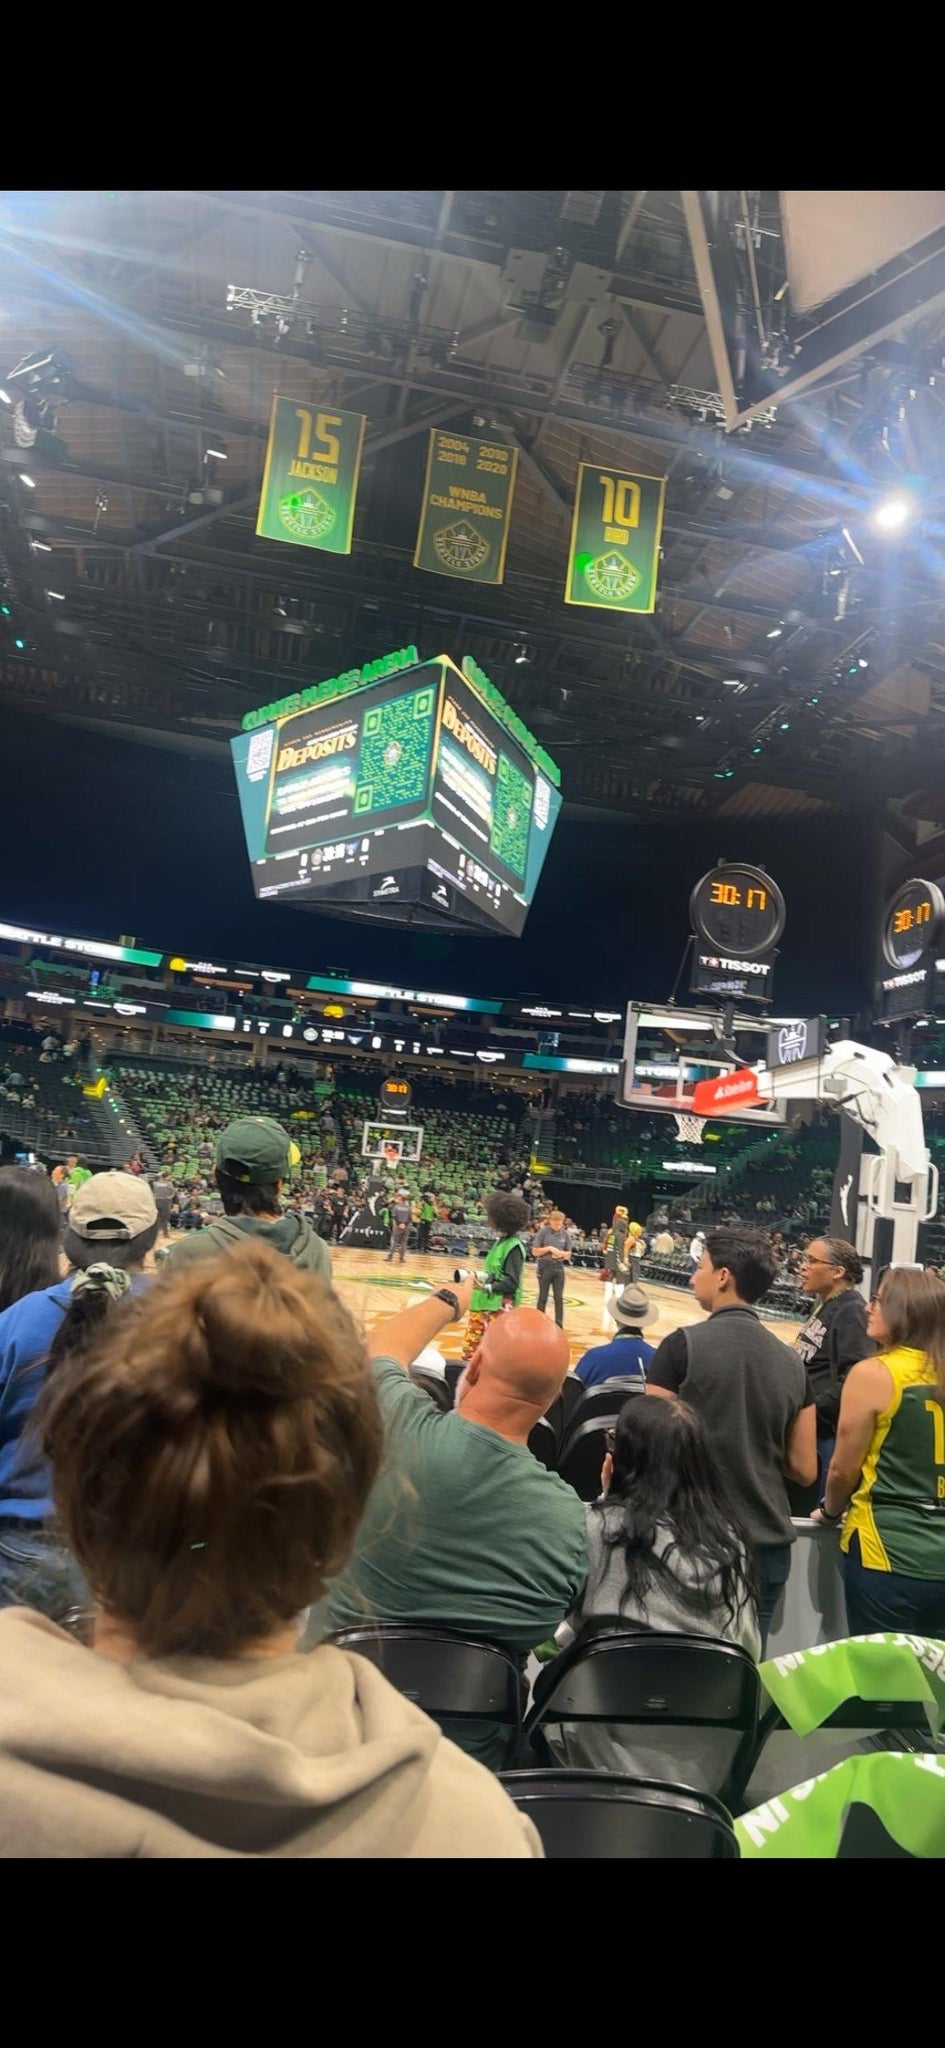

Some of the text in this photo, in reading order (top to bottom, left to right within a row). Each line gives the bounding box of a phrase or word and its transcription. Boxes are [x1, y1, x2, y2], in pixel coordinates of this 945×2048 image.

[296, 408, 343, 465] 15
[438, 436, 508, 461] 2004 2010
[288, 459, 339, 485] JACKSON
[476, 459, 508, 475] 2020
[430, 494, 503, 519] CHAMPIONS
[449, 486, 486, 504] WNBA
[599, 475, 641, 528] 10
[710, 882, 766, 910] 30:17
[894, 902, 931, 933] 30:17
[719, 958, 770, 975] TISSOT
